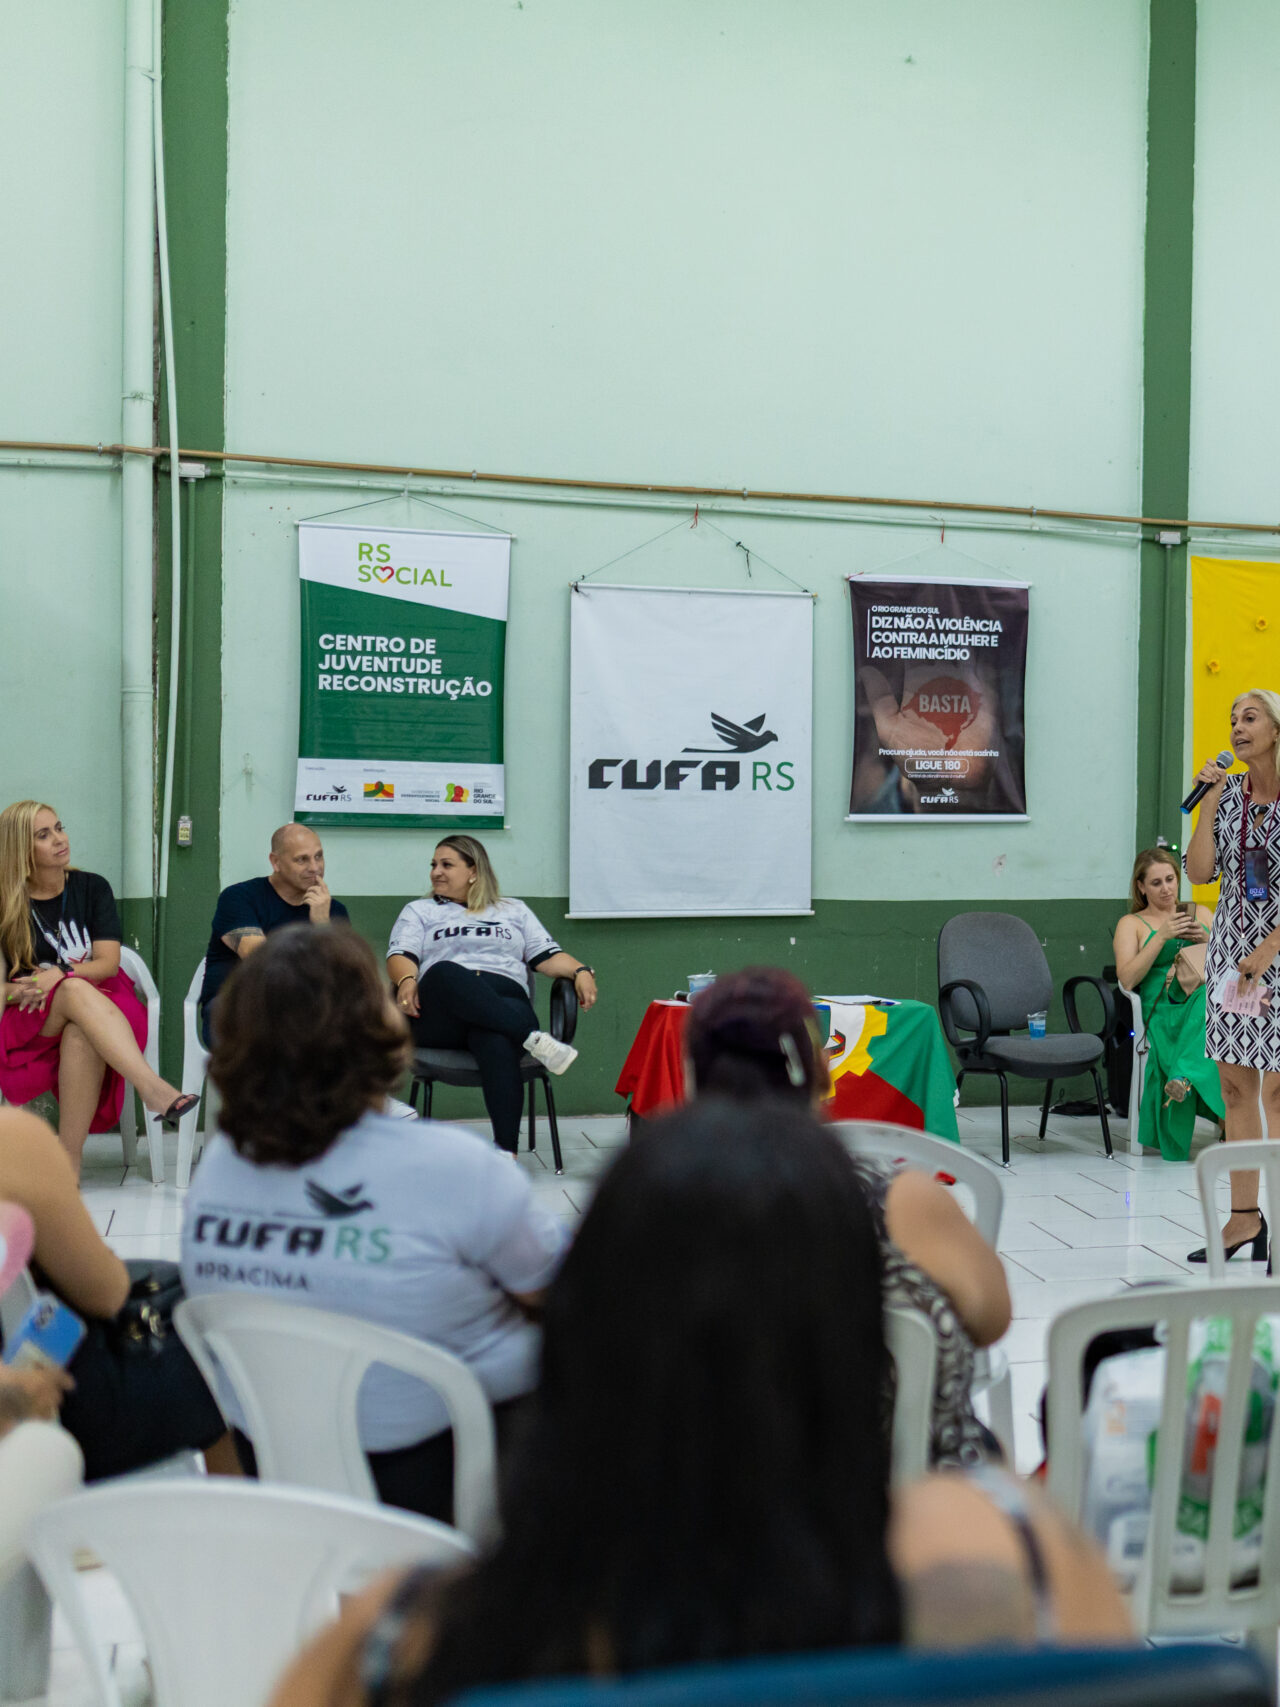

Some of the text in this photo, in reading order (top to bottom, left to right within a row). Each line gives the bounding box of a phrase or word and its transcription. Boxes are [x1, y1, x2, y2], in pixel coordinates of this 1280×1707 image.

[358, 542, 391, 563] RS
[878, 605, 890, 613] RIO
[890, 606, 917, 614] GRANDE
[917, 606, 928, 614] DO
[928, 607, 940, 615] SUL
[871, 614, 1003, 633] DIZ NÃO À VIOLÊNCIA
[318, 634, 437, 655] CENTRO DE
[871, 631, 999, 648] CONTRA A MULHER E
[871, 644, 970, 661] AO FEMINICÍDIO
[318, 654, 443, 675] JUVENTUDE
[318, 674, 492, 701] RECONSTRUÇÃO
[919, 694, 971, 713] BASTA
[878, 748, 906, 756] Procure
[588, 758, 795, 791] CUFA RS
[915, 760, 961, 771] LIGUE 180
[306, 793, 352, 802] CUFA RS
[920, 796, 959, 804] CUFA RS
[433, 926, 513, 941] CUFA RS
[193, 1214, 393, 1264] CUFA RS
